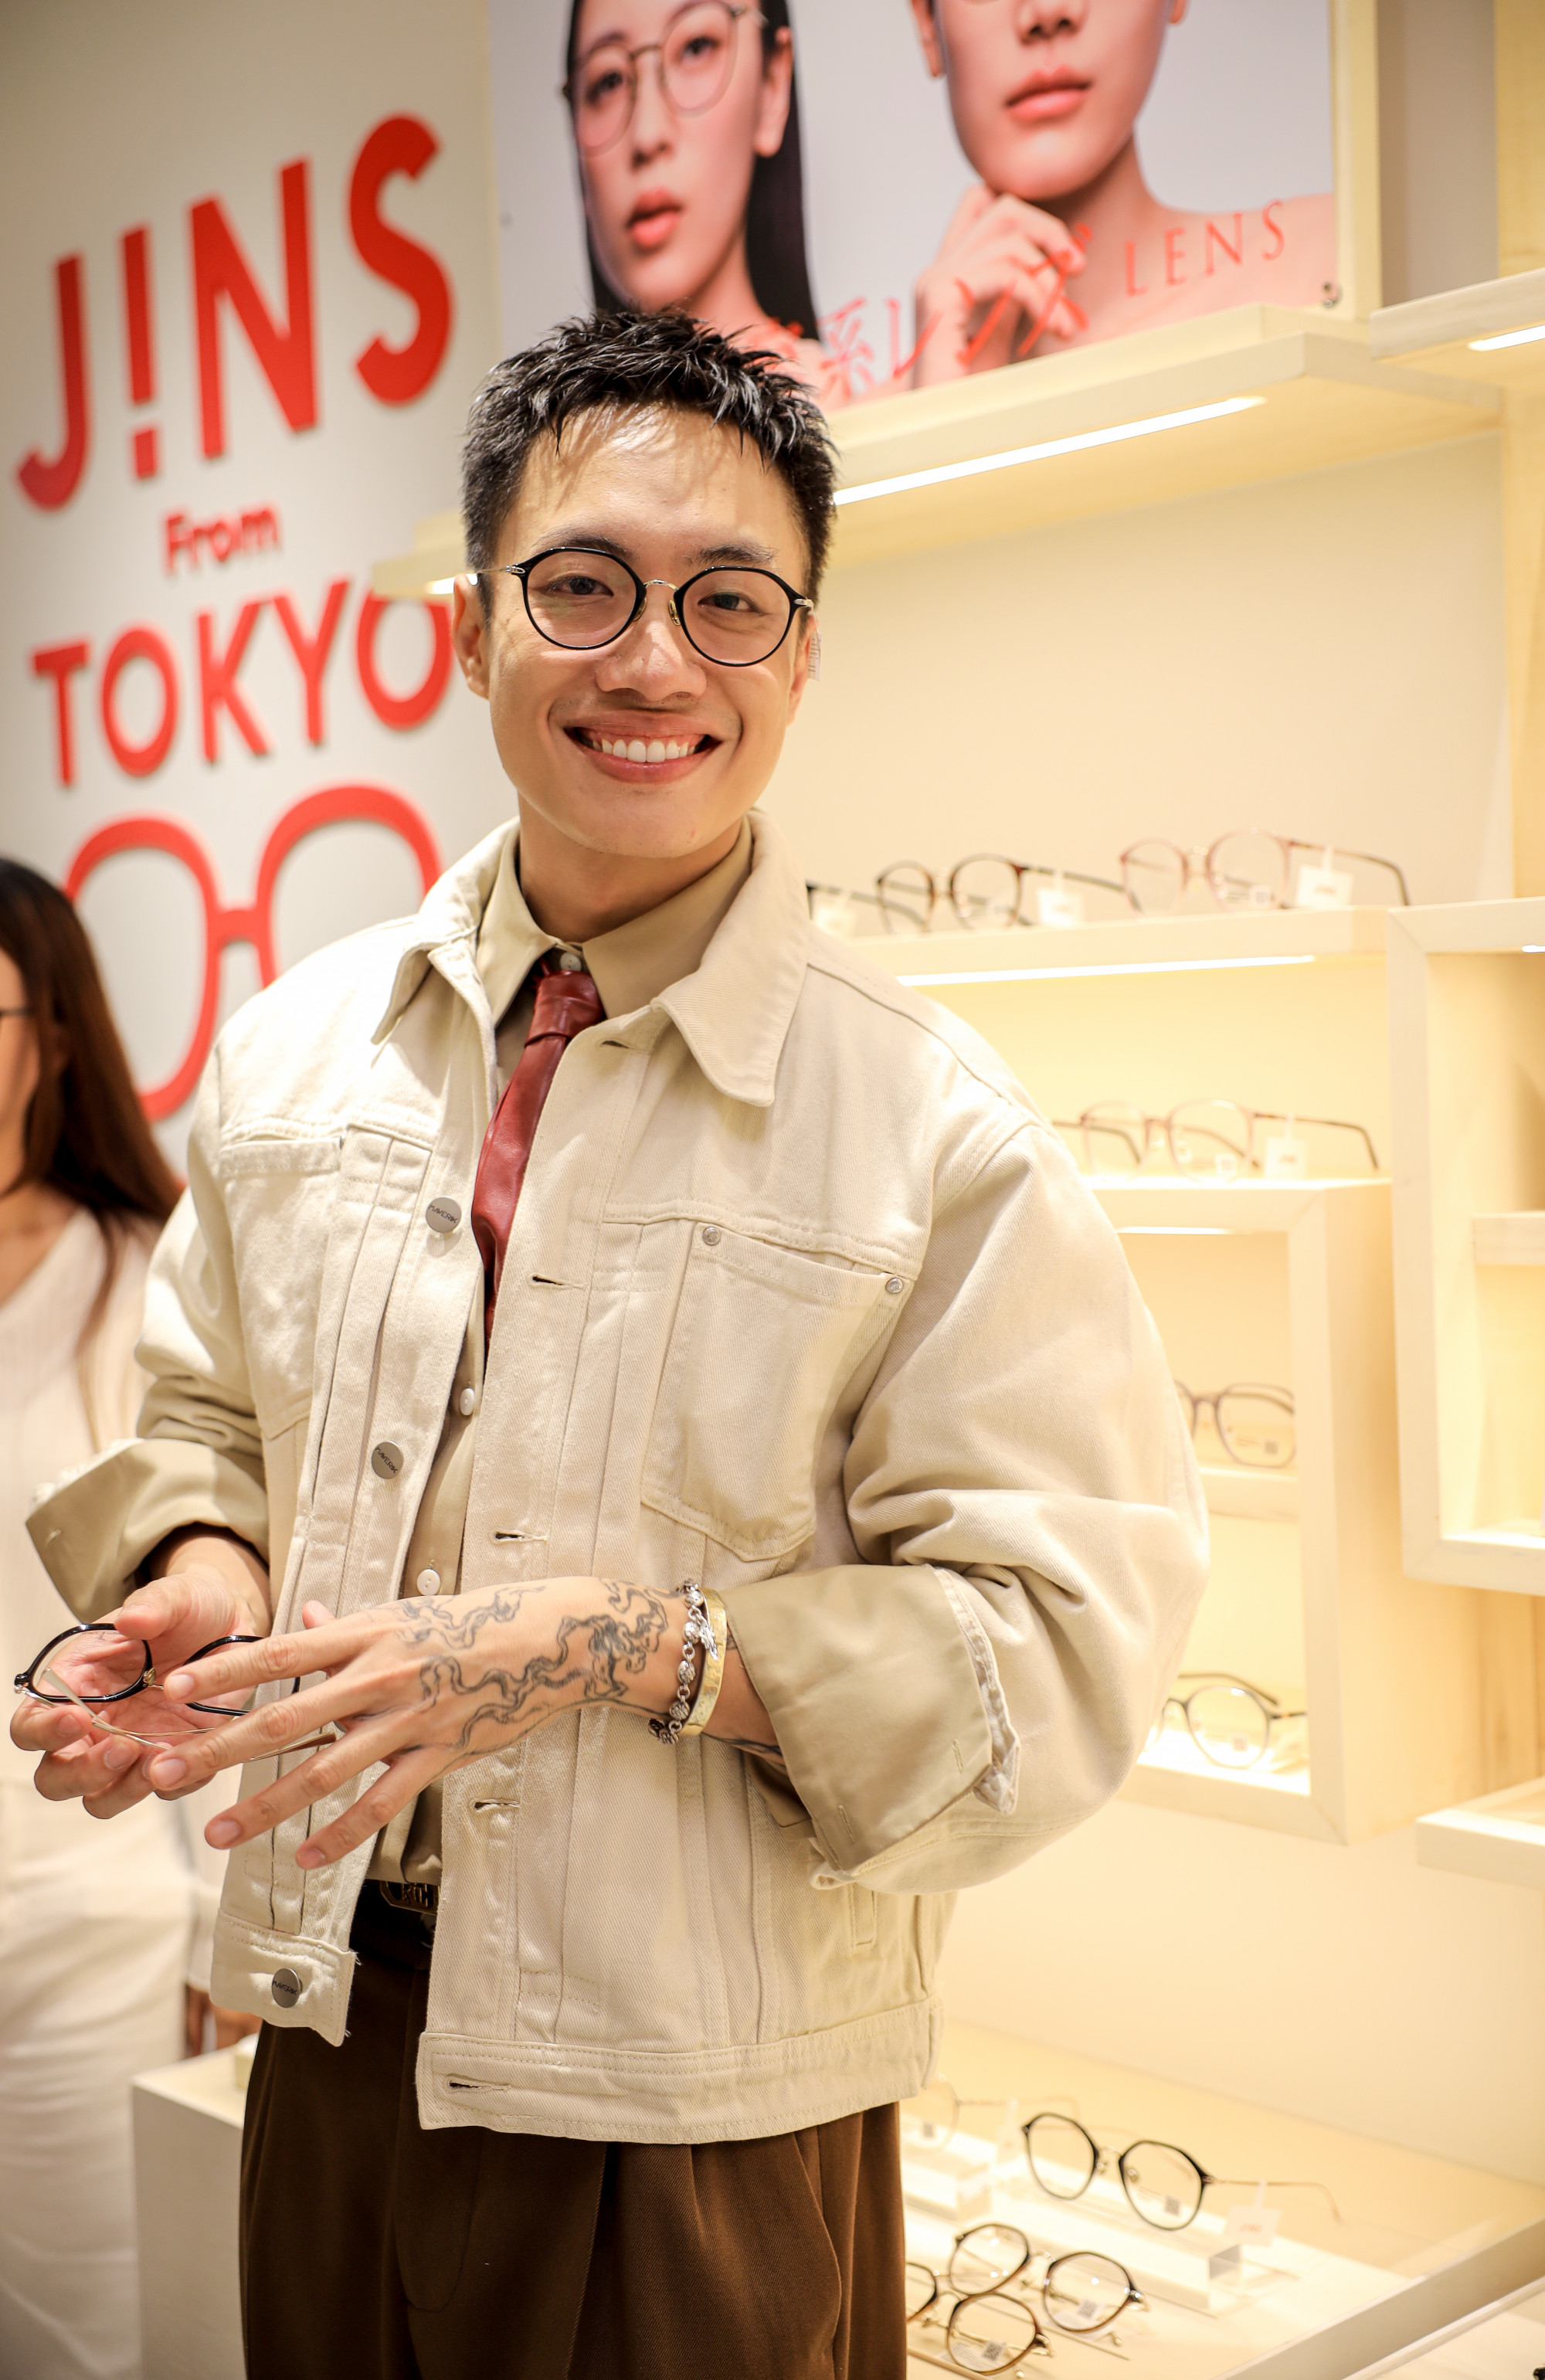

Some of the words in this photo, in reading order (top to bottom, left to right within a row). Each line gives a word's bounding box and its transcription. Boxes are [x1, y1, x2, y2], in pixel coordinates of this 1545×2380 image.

[1124, 199, 1285, 297] LENS
[163, 506, 279, 572] From
[31, 578, 454, 785] TOKYO
[428, 1204, 458, 1224] MAVERIK
[375, 1447, 399, 1473] MAVERIK
[272, 1980, 297, 1995] MAVERIK
